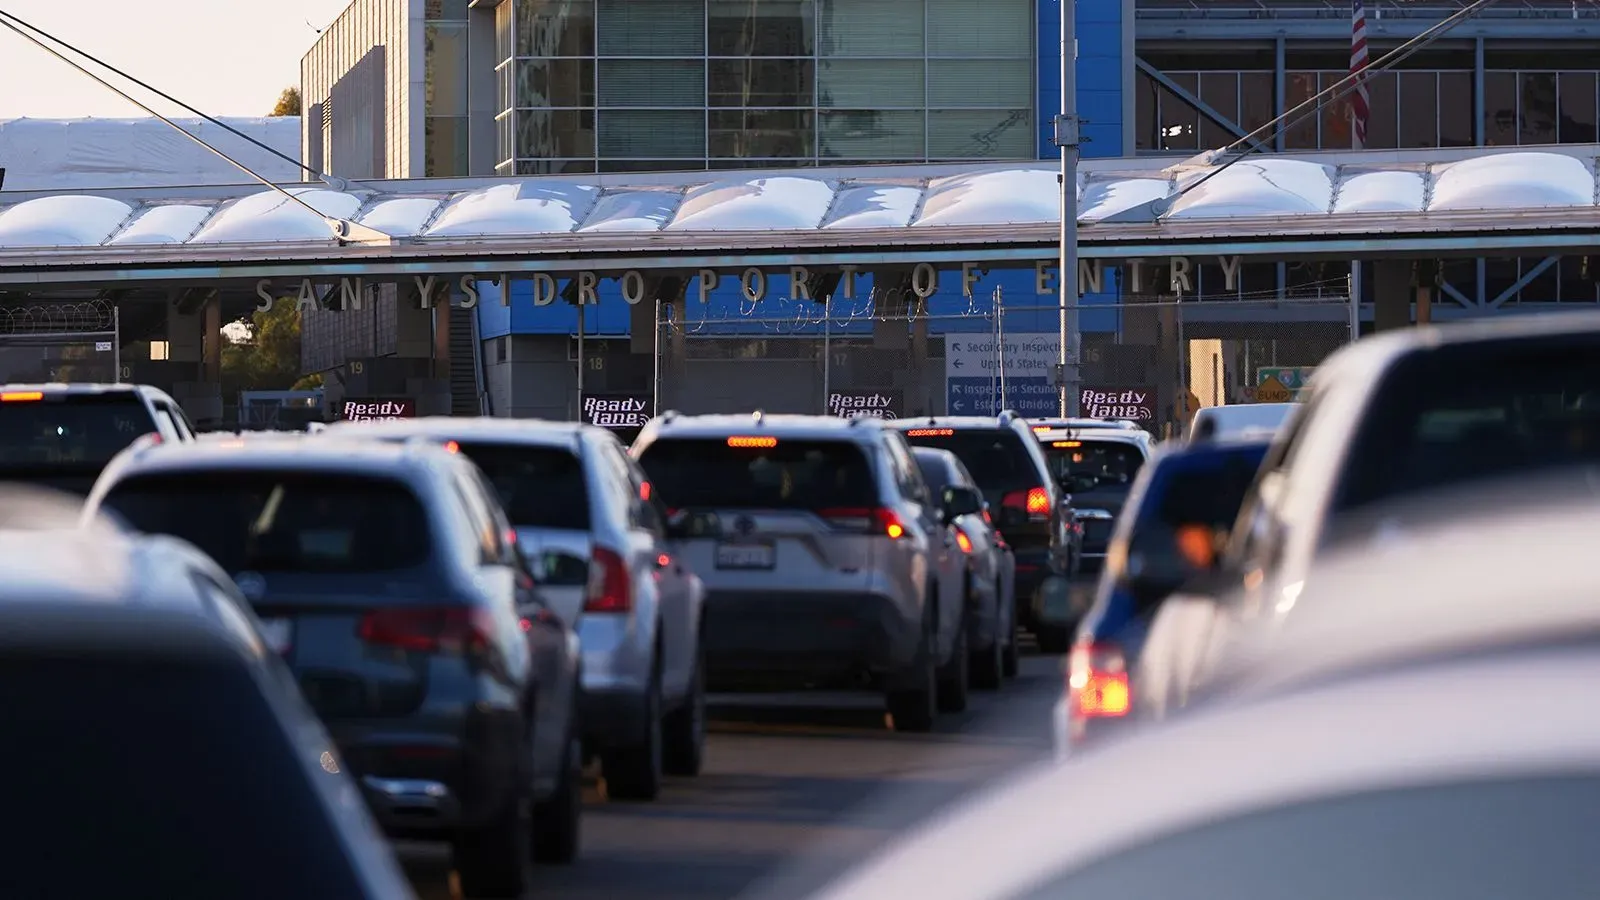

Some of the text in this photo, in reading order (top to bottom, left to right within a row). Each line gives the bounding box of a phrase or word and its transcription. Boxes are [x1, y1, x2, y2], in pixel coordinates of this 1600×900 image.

[256, 256, 1241, 312] SAN YSIDRO PORT OF ENTRY
[350, 361, 363, 374] 19
[589, 357, 603, 370] 18
[834, 353, 847, 366] 17
[981, 359, 1048, 369] Untd States
[585, 398, 646, 417] Ready
[829, 393, 891, 413] Ready
[974, 400, 1056, 410] Estds Unidos
[1082, 390, 1146, 410] Ready
[344, 401, 405, 420] Ready
[1090, 404, 1139, 420] Lane
[593, 411, 641, 427] Lane
